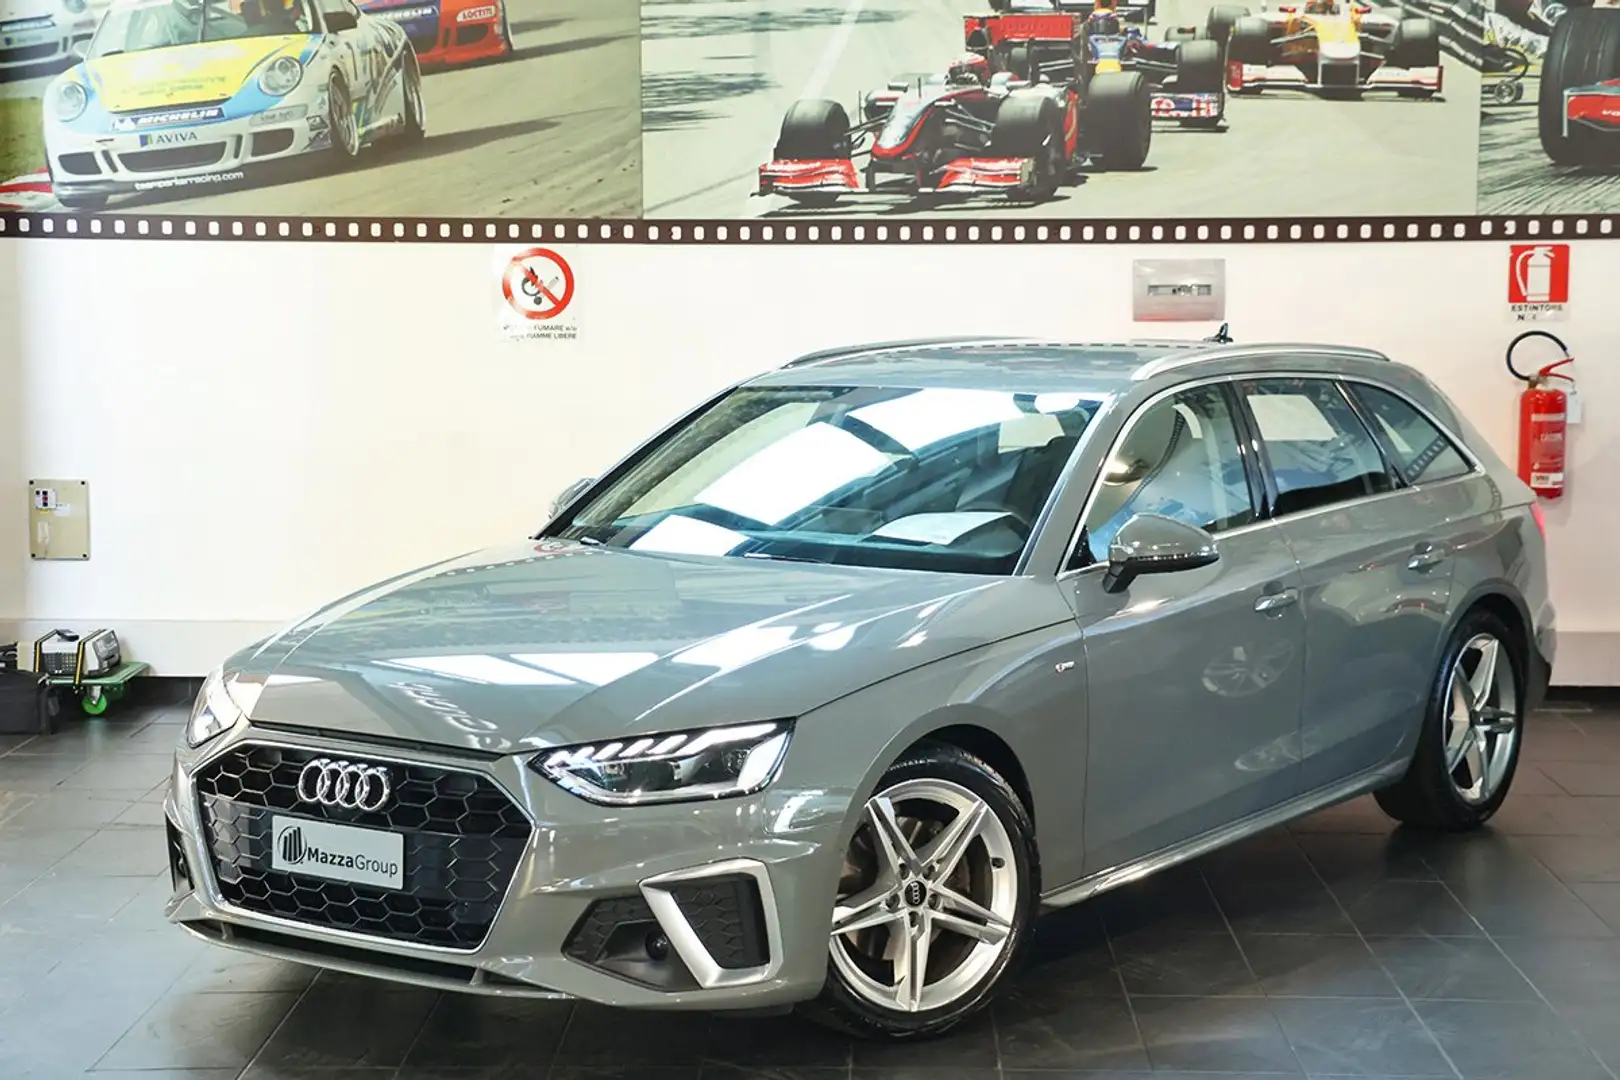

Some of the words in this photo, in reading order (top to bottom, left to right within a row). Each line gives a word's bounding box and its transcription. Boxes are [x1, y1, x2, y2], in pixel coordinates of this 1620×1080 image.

[155, 131, 198, 145] AVIVA
[1511, 304, 1563, 312] ESTINTORE
[307, 846, 398, 878] MazzaGroup
